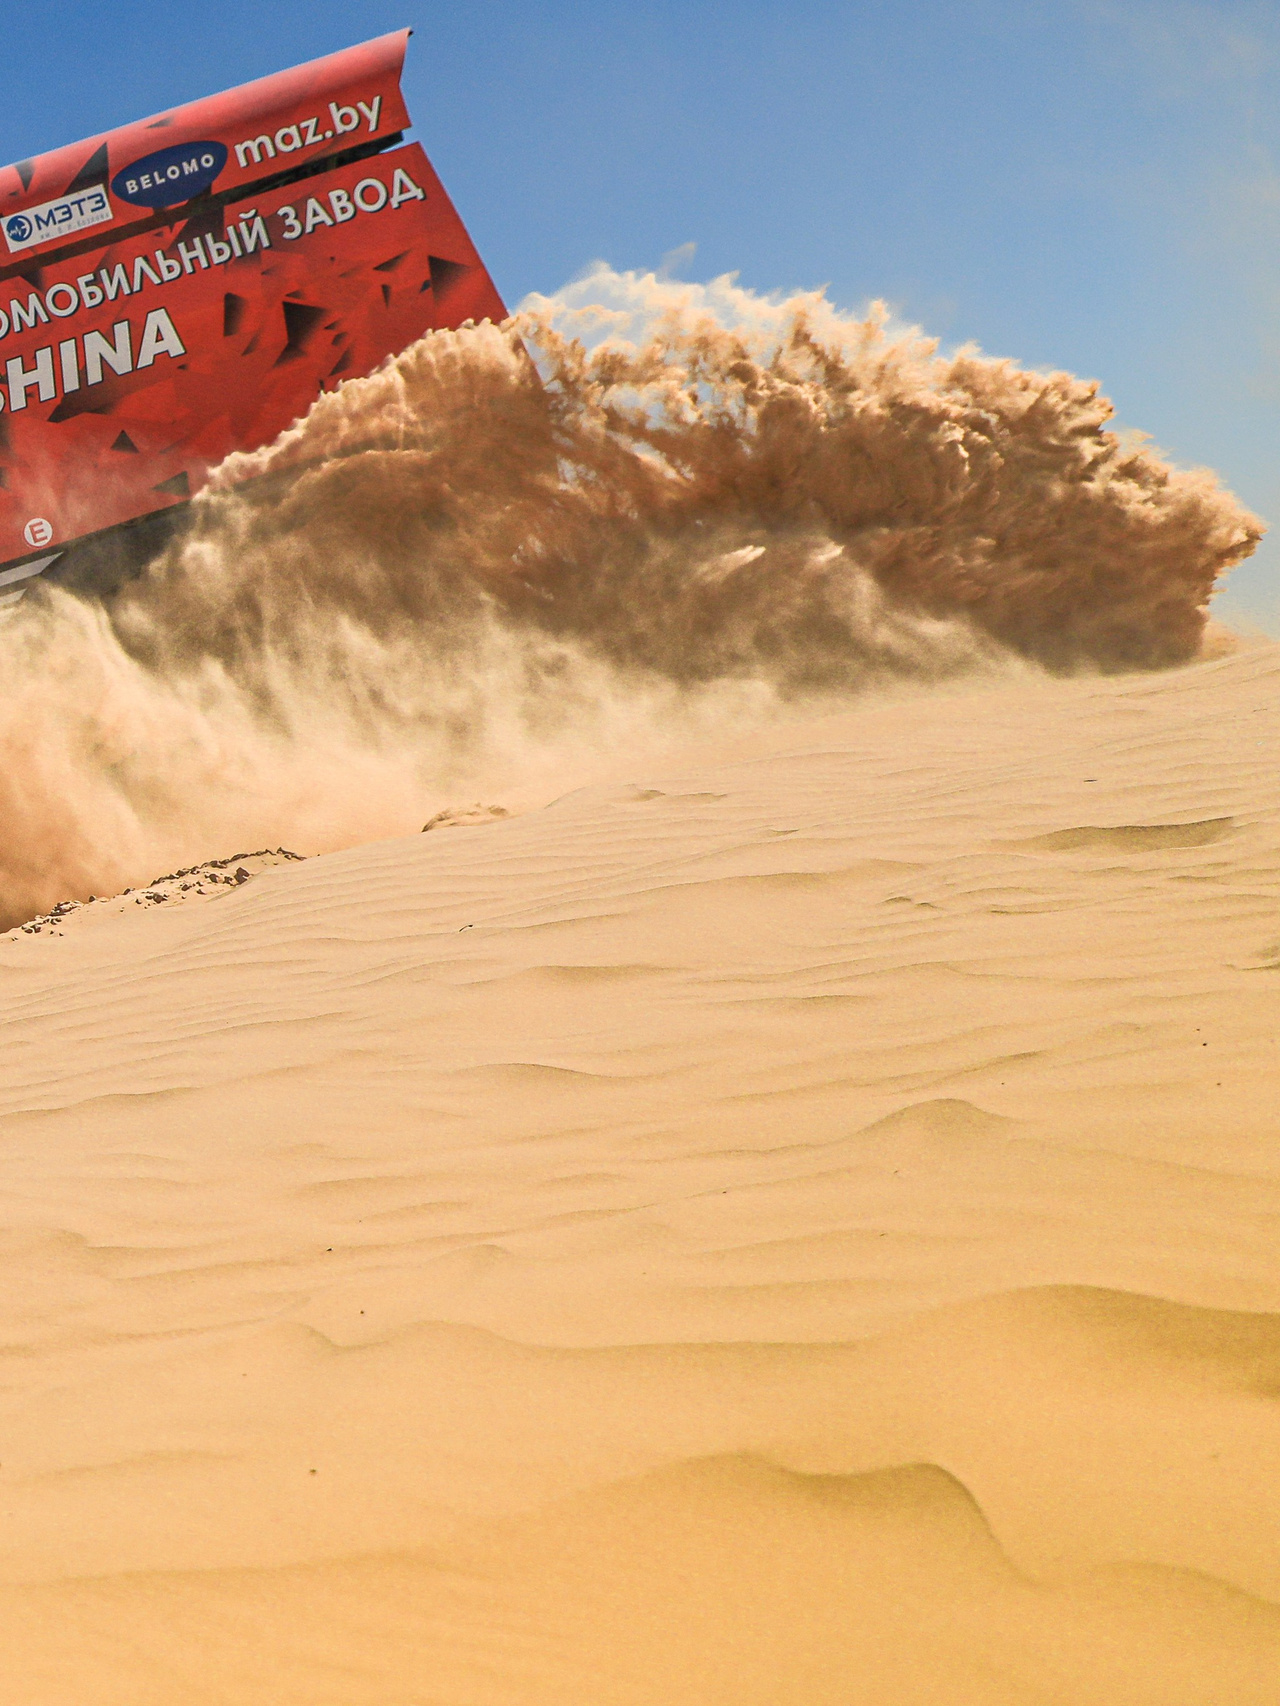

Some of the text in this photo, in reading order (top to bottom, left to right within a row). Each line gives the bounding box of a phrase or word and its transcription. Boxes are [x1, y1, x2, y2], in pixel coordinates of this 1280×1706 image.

[233, 95, 382, 168] maz.by
[125, 153, 215, 195] BELOMO
[34, 192, 106, 231] МЭТЗ
[280, 168, 425, 240] ЗАВОД
